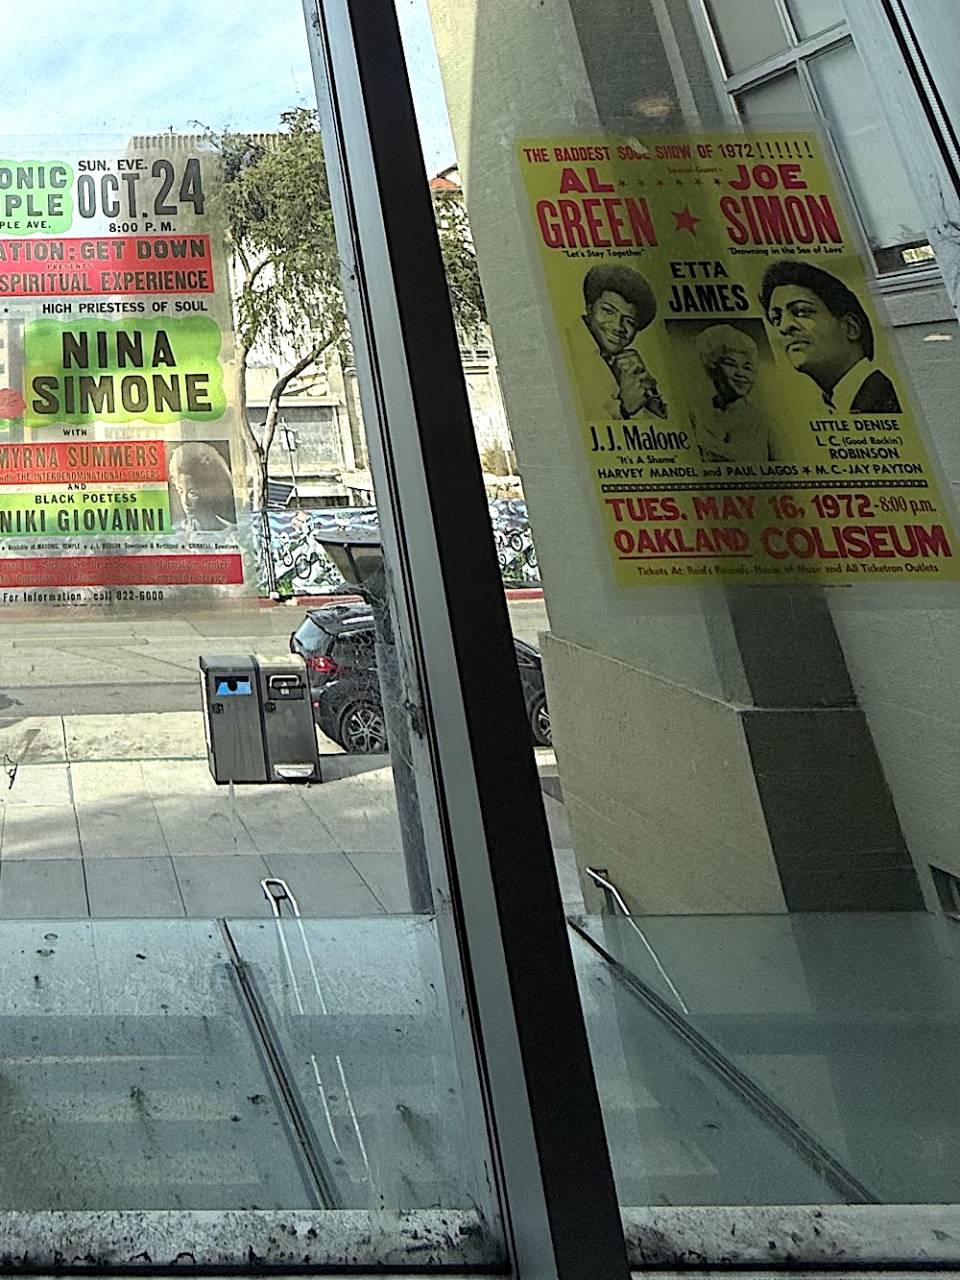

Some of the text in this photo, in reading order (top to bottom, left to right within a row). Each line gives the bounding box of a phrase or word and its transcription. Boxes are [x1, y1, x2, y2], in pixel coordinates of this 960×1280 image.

[523, 148, 550, 163] THE
[553, 146, 611, 162] BADDEST
[656, 144, 691, 160] SHOW
[697, 144, 713, 159] OF
[78, 159, 148, 171] SUN. EVE.
[76, 158, 205, 218] OCT. 24
[560, 167, 615, 194] AL
[728, 164, 808, 190] JOE
[26, 220, 52, 229] AVE.
[108, 222, 138, 232] 8:00
[536, 198, 659, 249] GREEN
[720, 195, 842, 245] SIMON
[80, 241, 126, 261] GET
[137, 239, 205, 259] DOWN
[669, 261, 729, 278] ETTA
[0, 272, 91, 293] SPIRITUAL
[101, 270, 209, 291] EXPERIENCE
[42, 301, 208, 314] HIGH PRIESTESS OF SOUL
[669, 285, 749, 312] JAMES
[62, 330, 177, 369] NINA
[31, 374, 213, 414] SIMONE
[809, 419, 900, 431] LITTLE DENISE
[623, 425, 690, 450] Malone
[843, 436, 867, 447] (Good
[68, 445, 159, 468] SUMMERS
[829, 447, 900, 459] ROBINSON
[16, 473, 30, 481] THE
[127, 471, 160, 479] SINGERS
[598, 463, 923, 478] HARVEY MANDEL and PAUL LAGOS PAYTON
[35, 493, 137, 504] BLACK POETESS
[605, 497, 688, 522] TUES.
[692, 495, 756, 520] MAY
[768, 495, 805, 519] 16,
[910, 498, 937, 516] p.m.
[0, 508, 164, 533] NIKI GIOVANNI
[614, 525, 952, 560] OAKLAND COLISEUM
[3, 593, 19, 603] For
[94, 591, 112, 601] call
